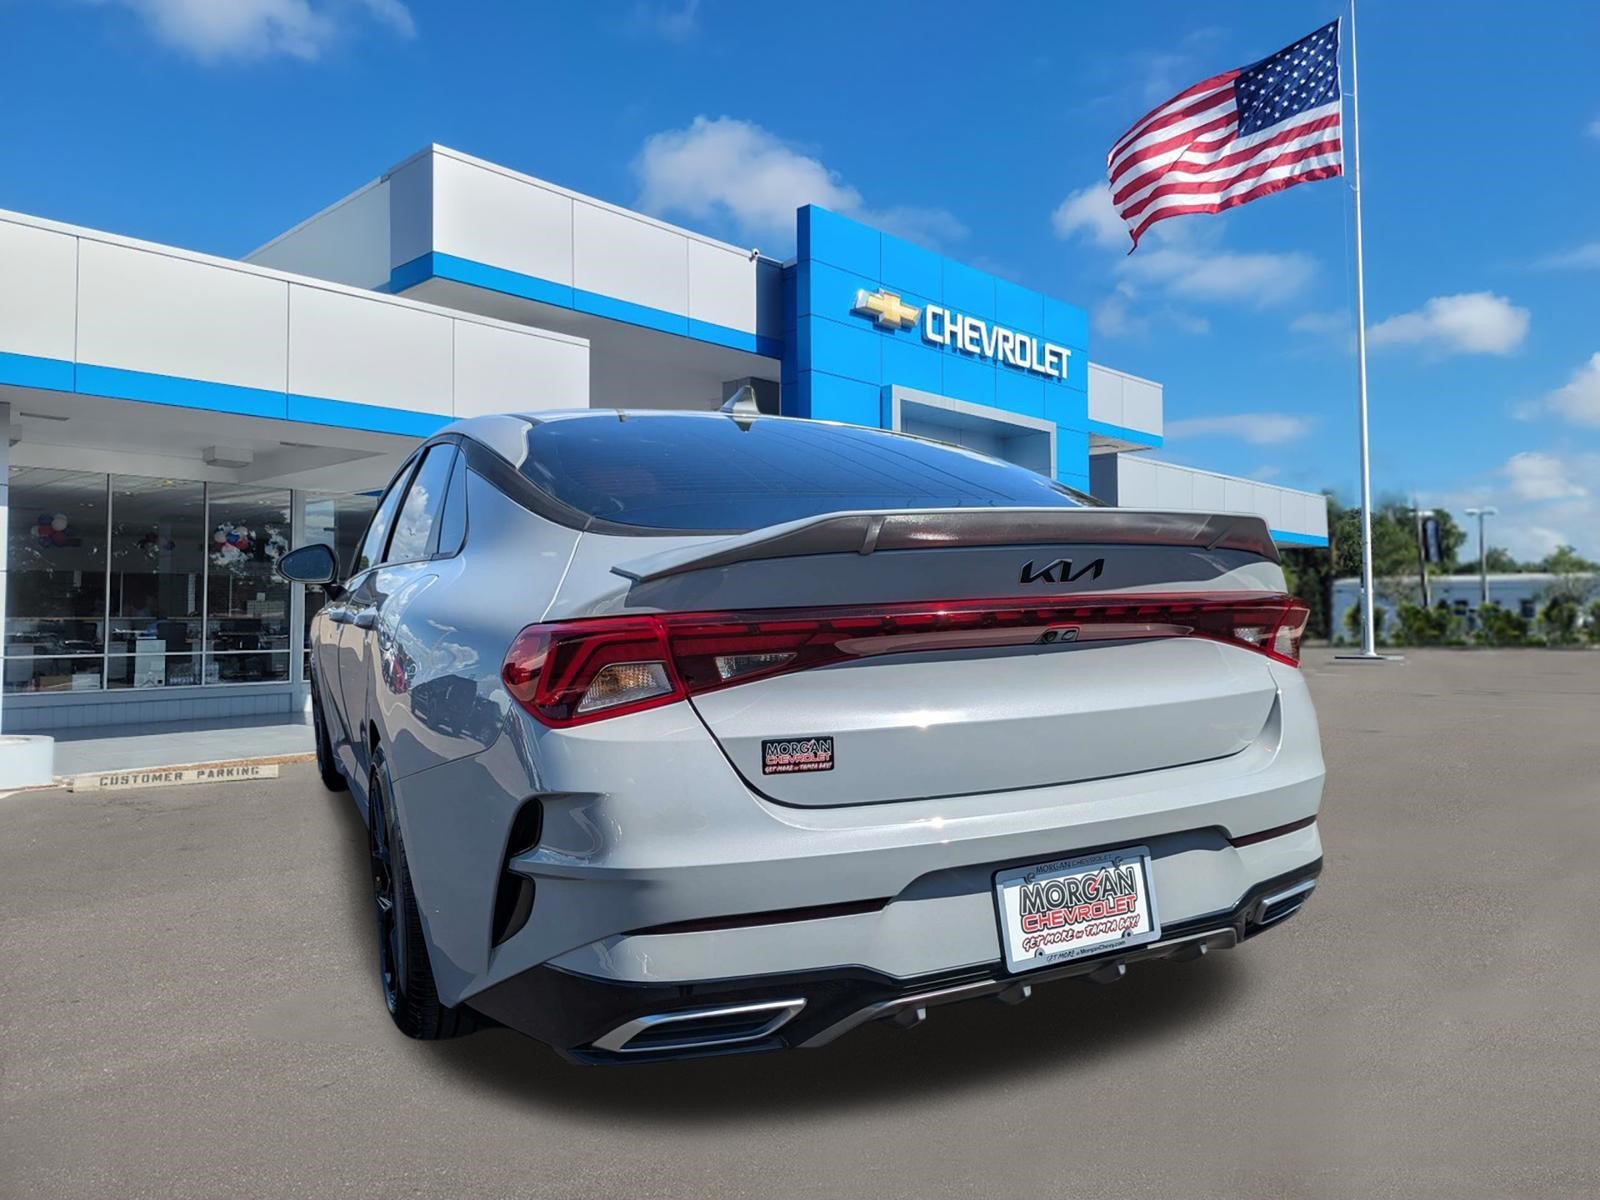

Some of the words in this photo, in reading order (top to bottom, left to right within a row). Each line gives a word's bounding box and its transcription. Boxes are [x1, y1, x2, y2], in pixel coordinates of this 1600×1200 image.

[925, 304, 1072, 379] CHEVROLET
[1020, 559, 1105, 583] KIA
[766, 739, 832, 757] MORGAN
[766, 751, 831, 765] CHEVROLET
[100, 772, 183, 786] CUSTOMER
[196, 766, 259, 779] PARKING
[1035, 861, 1071, 874] MORGAN
[1019, 867, 1137, 917] MORGAN
[1021, 894, 1137, 934] CHEVROLET
[1023, 936, 1044, 952] GET
[1044, 929, 1074, 945] MORE
[1085, 919, 1117, 936] TAMPA
